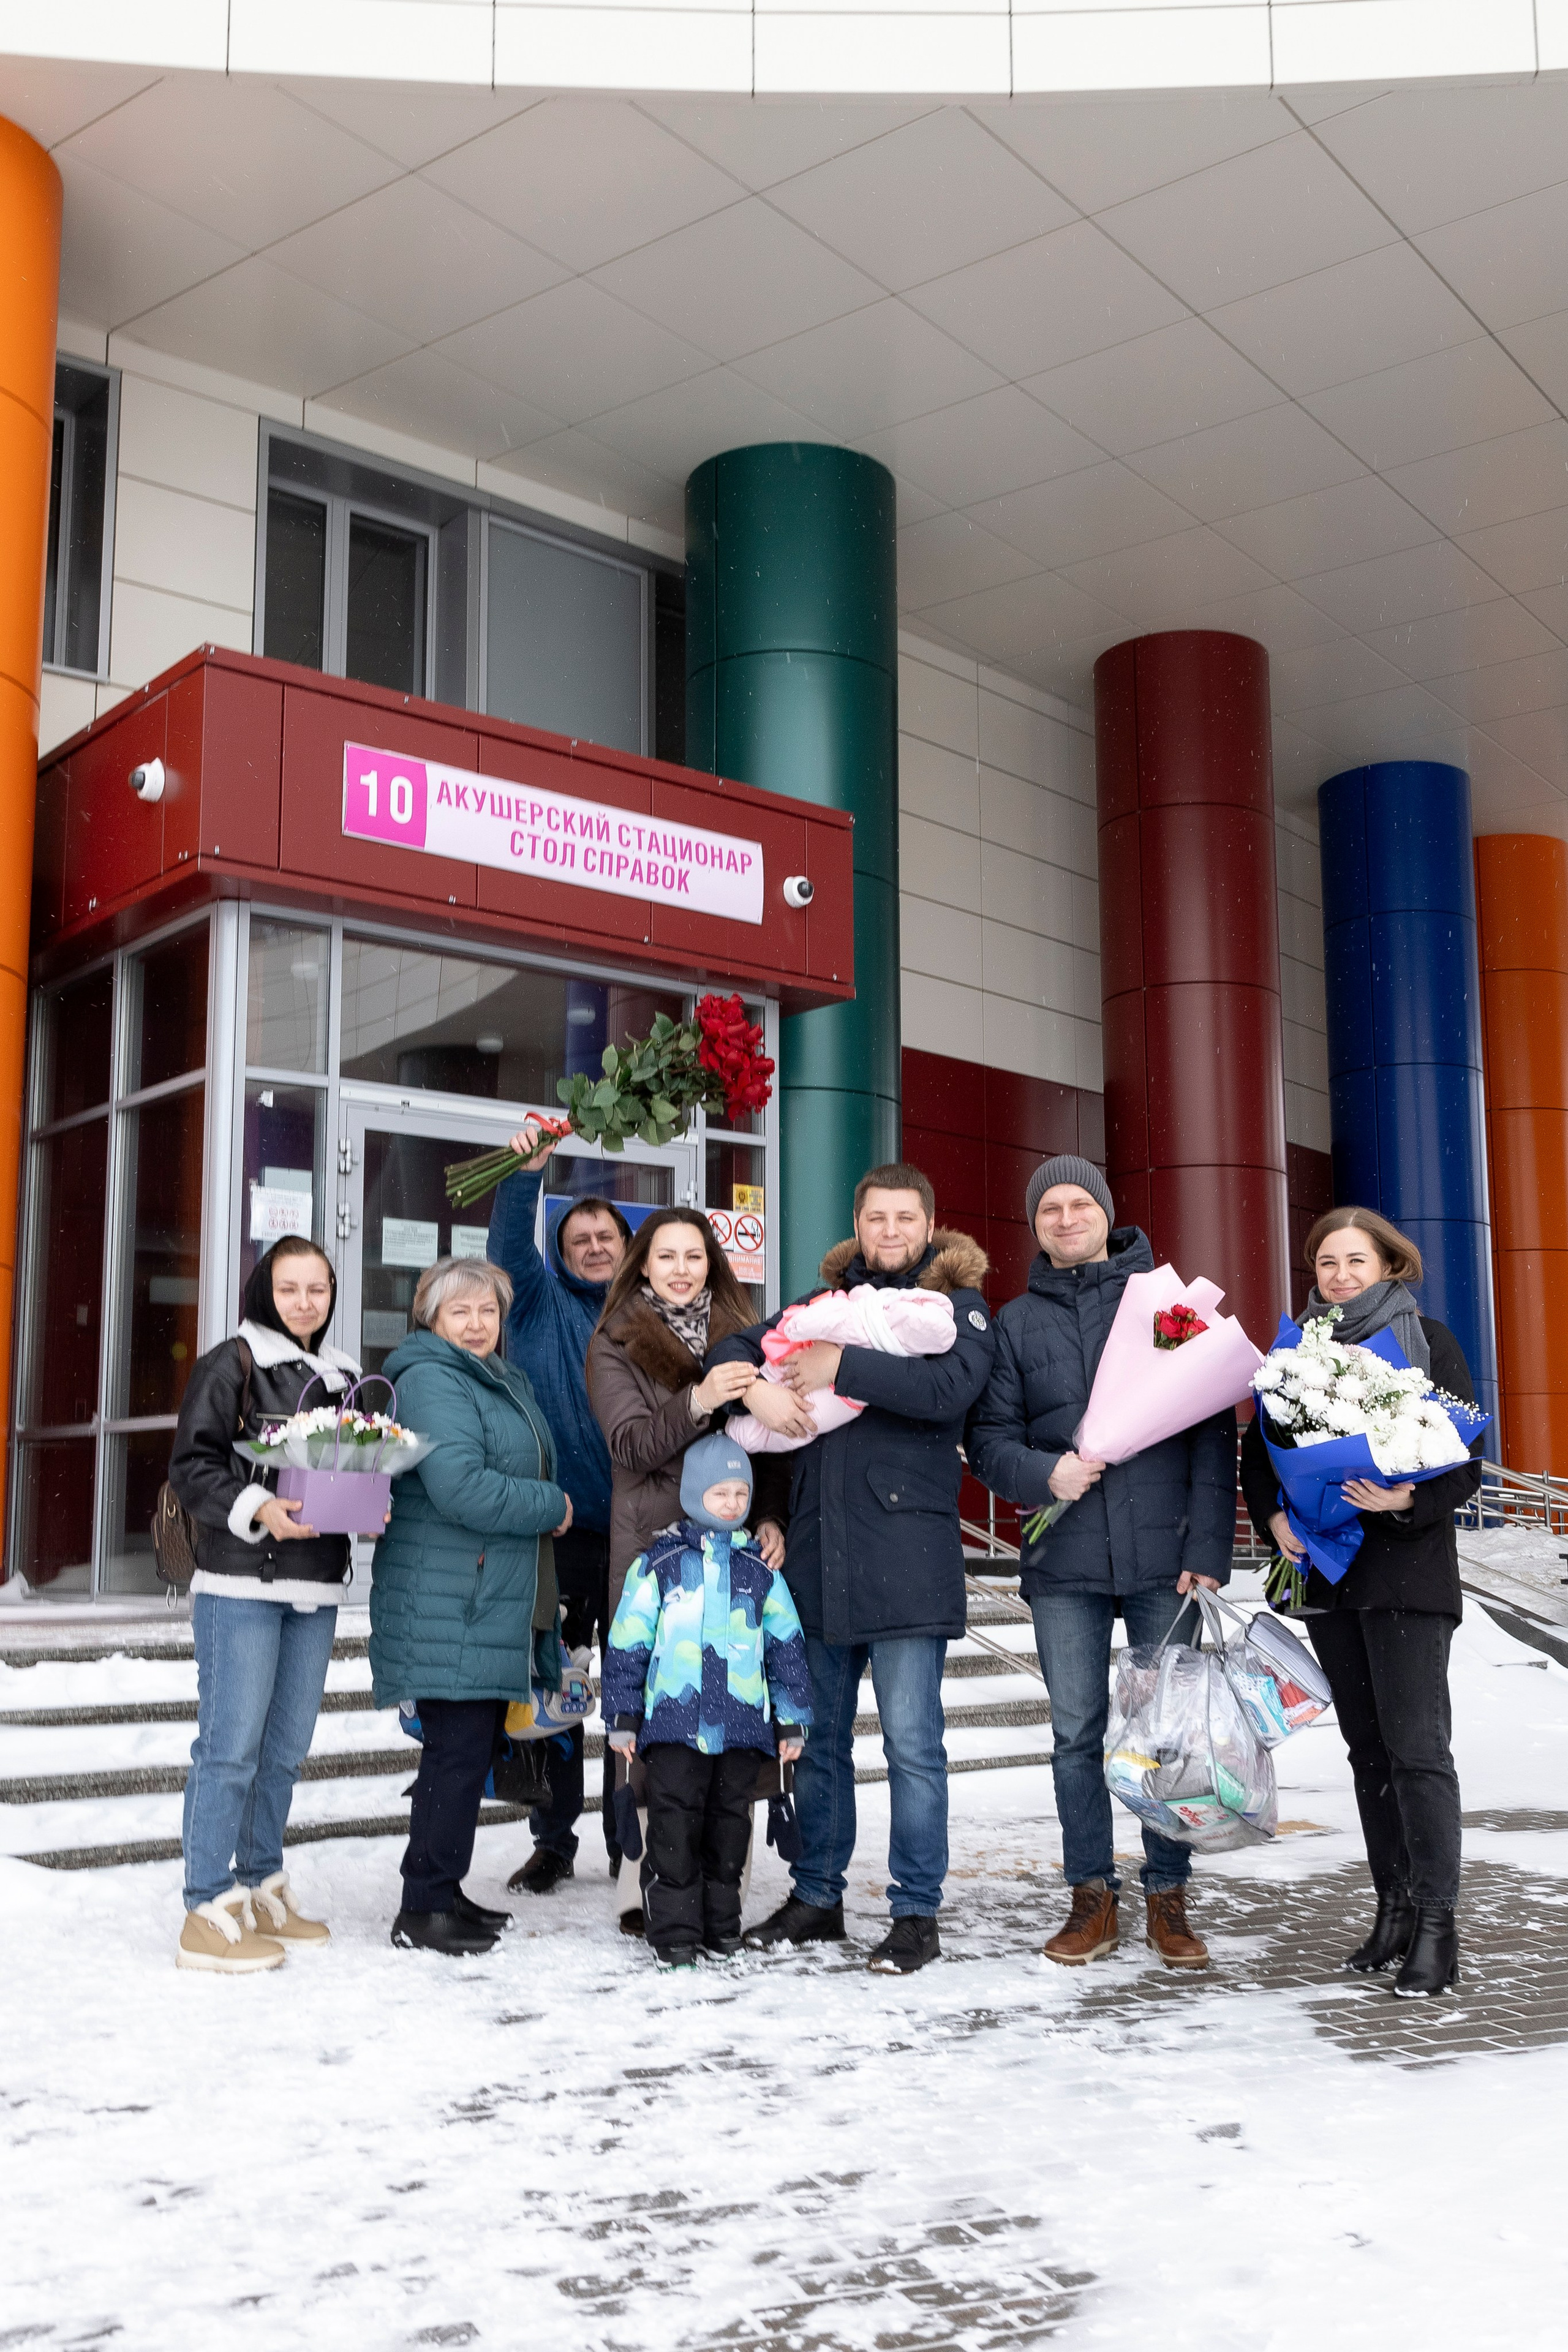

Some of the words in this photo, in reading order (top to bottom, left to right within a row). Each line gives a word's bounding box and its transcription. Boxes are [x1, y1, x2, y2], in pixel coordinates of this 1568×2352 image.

[360, 769, 413, 824] 10
[437, 780, 611, 843] АКУШЕРСКИЙ
[618, 823, 753, 876] СТАЦИОНАР
[510, 829, 576, 869] СТОЛ
[583, 847, 691, 895] СПРАВОК
